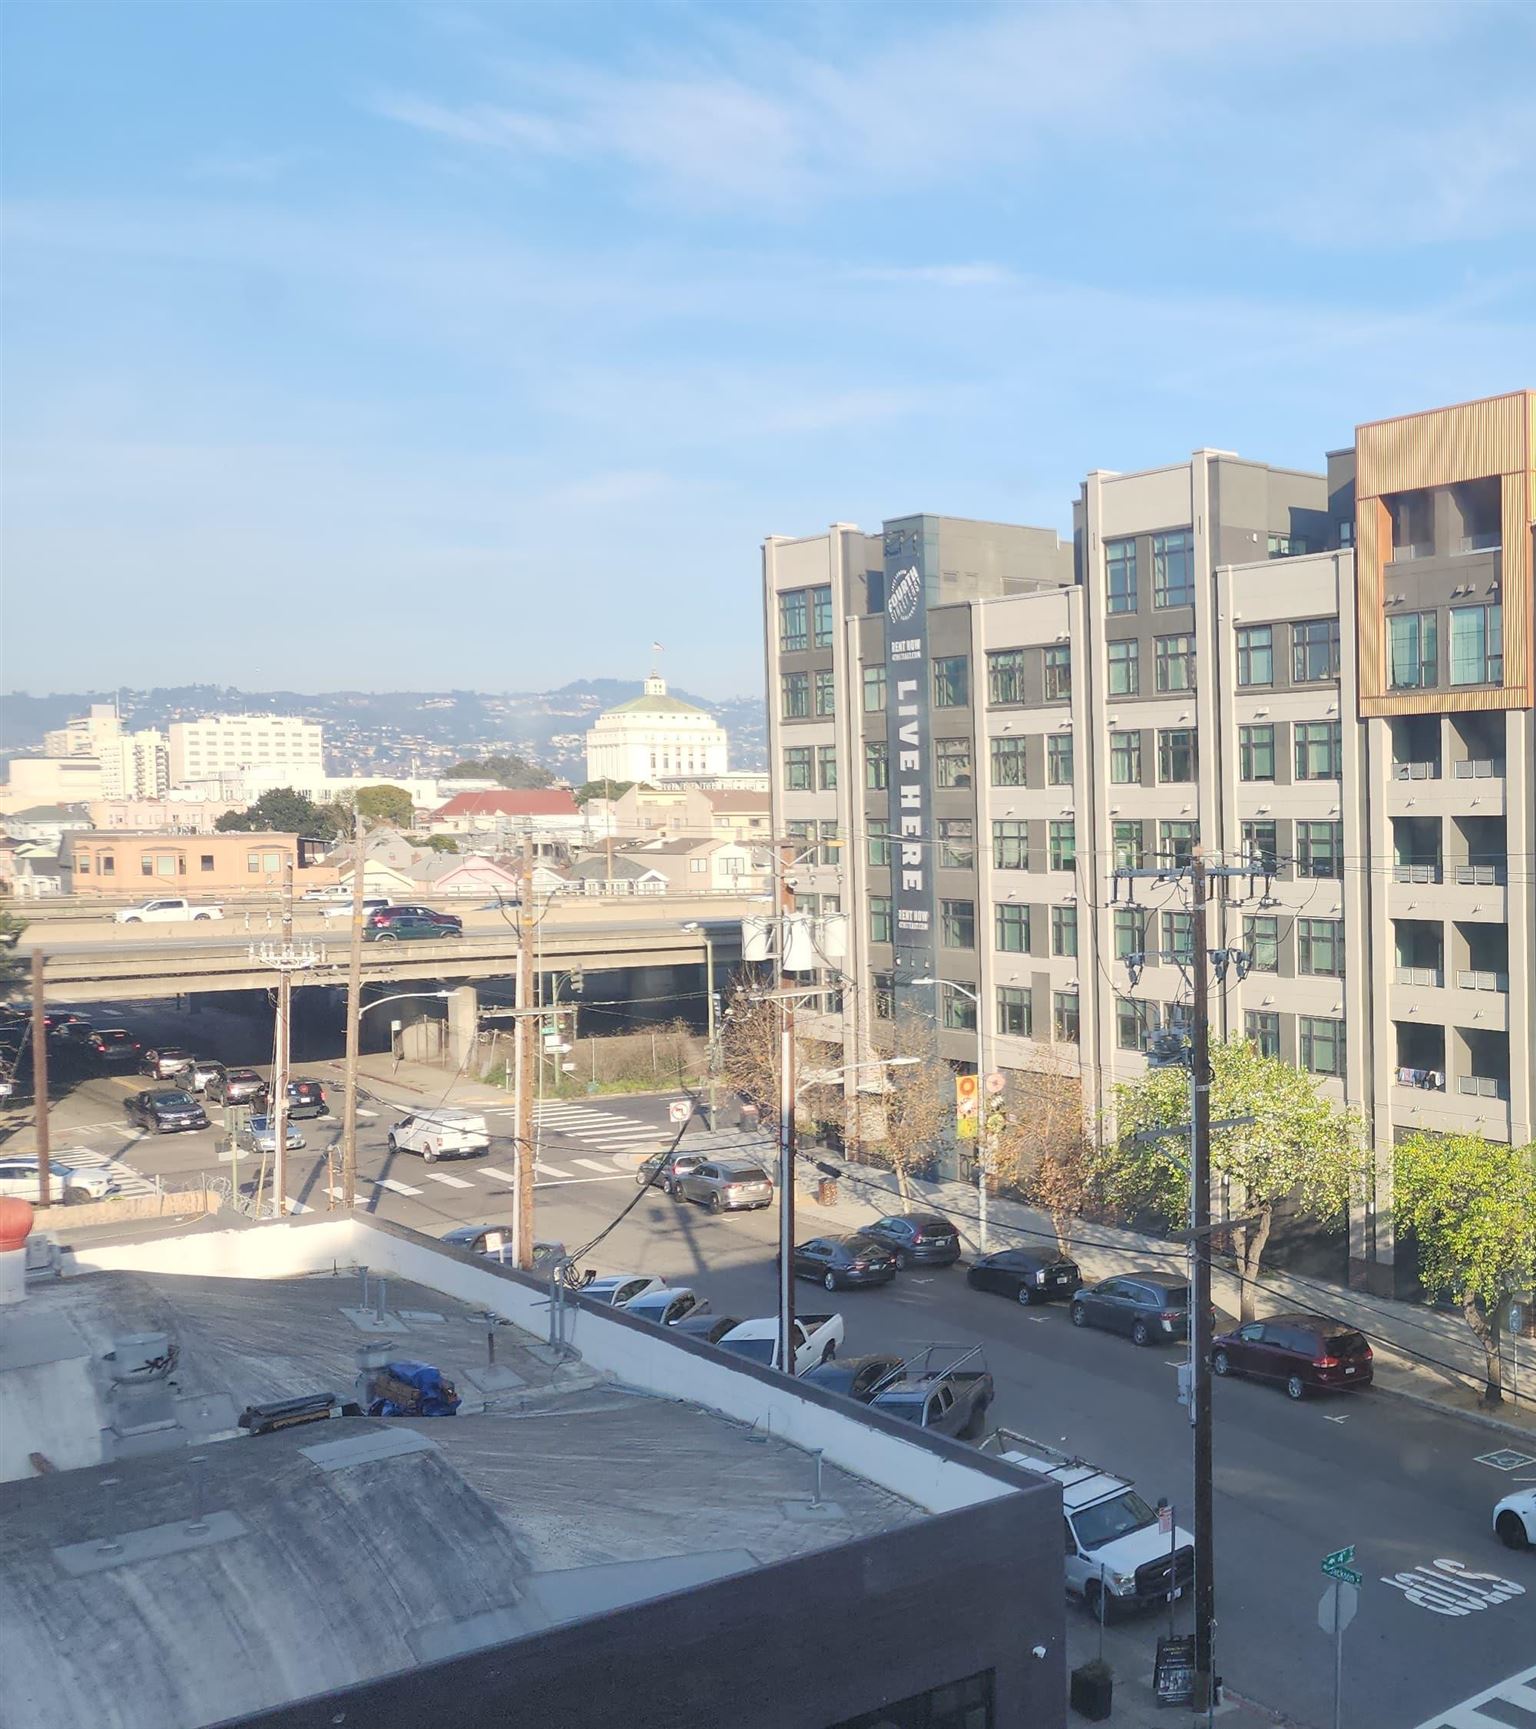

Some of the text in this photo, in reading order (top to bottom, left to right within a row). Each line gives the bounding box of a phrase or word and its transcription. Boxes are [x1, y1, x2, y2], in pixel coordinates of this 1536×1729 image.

[888, 565, 919, 613] FOURTH
[897, 680, 920, 772] LIVE
[900, 784, 923, 891] HERE
[1380, 1558, 1526, 1616] STOP
